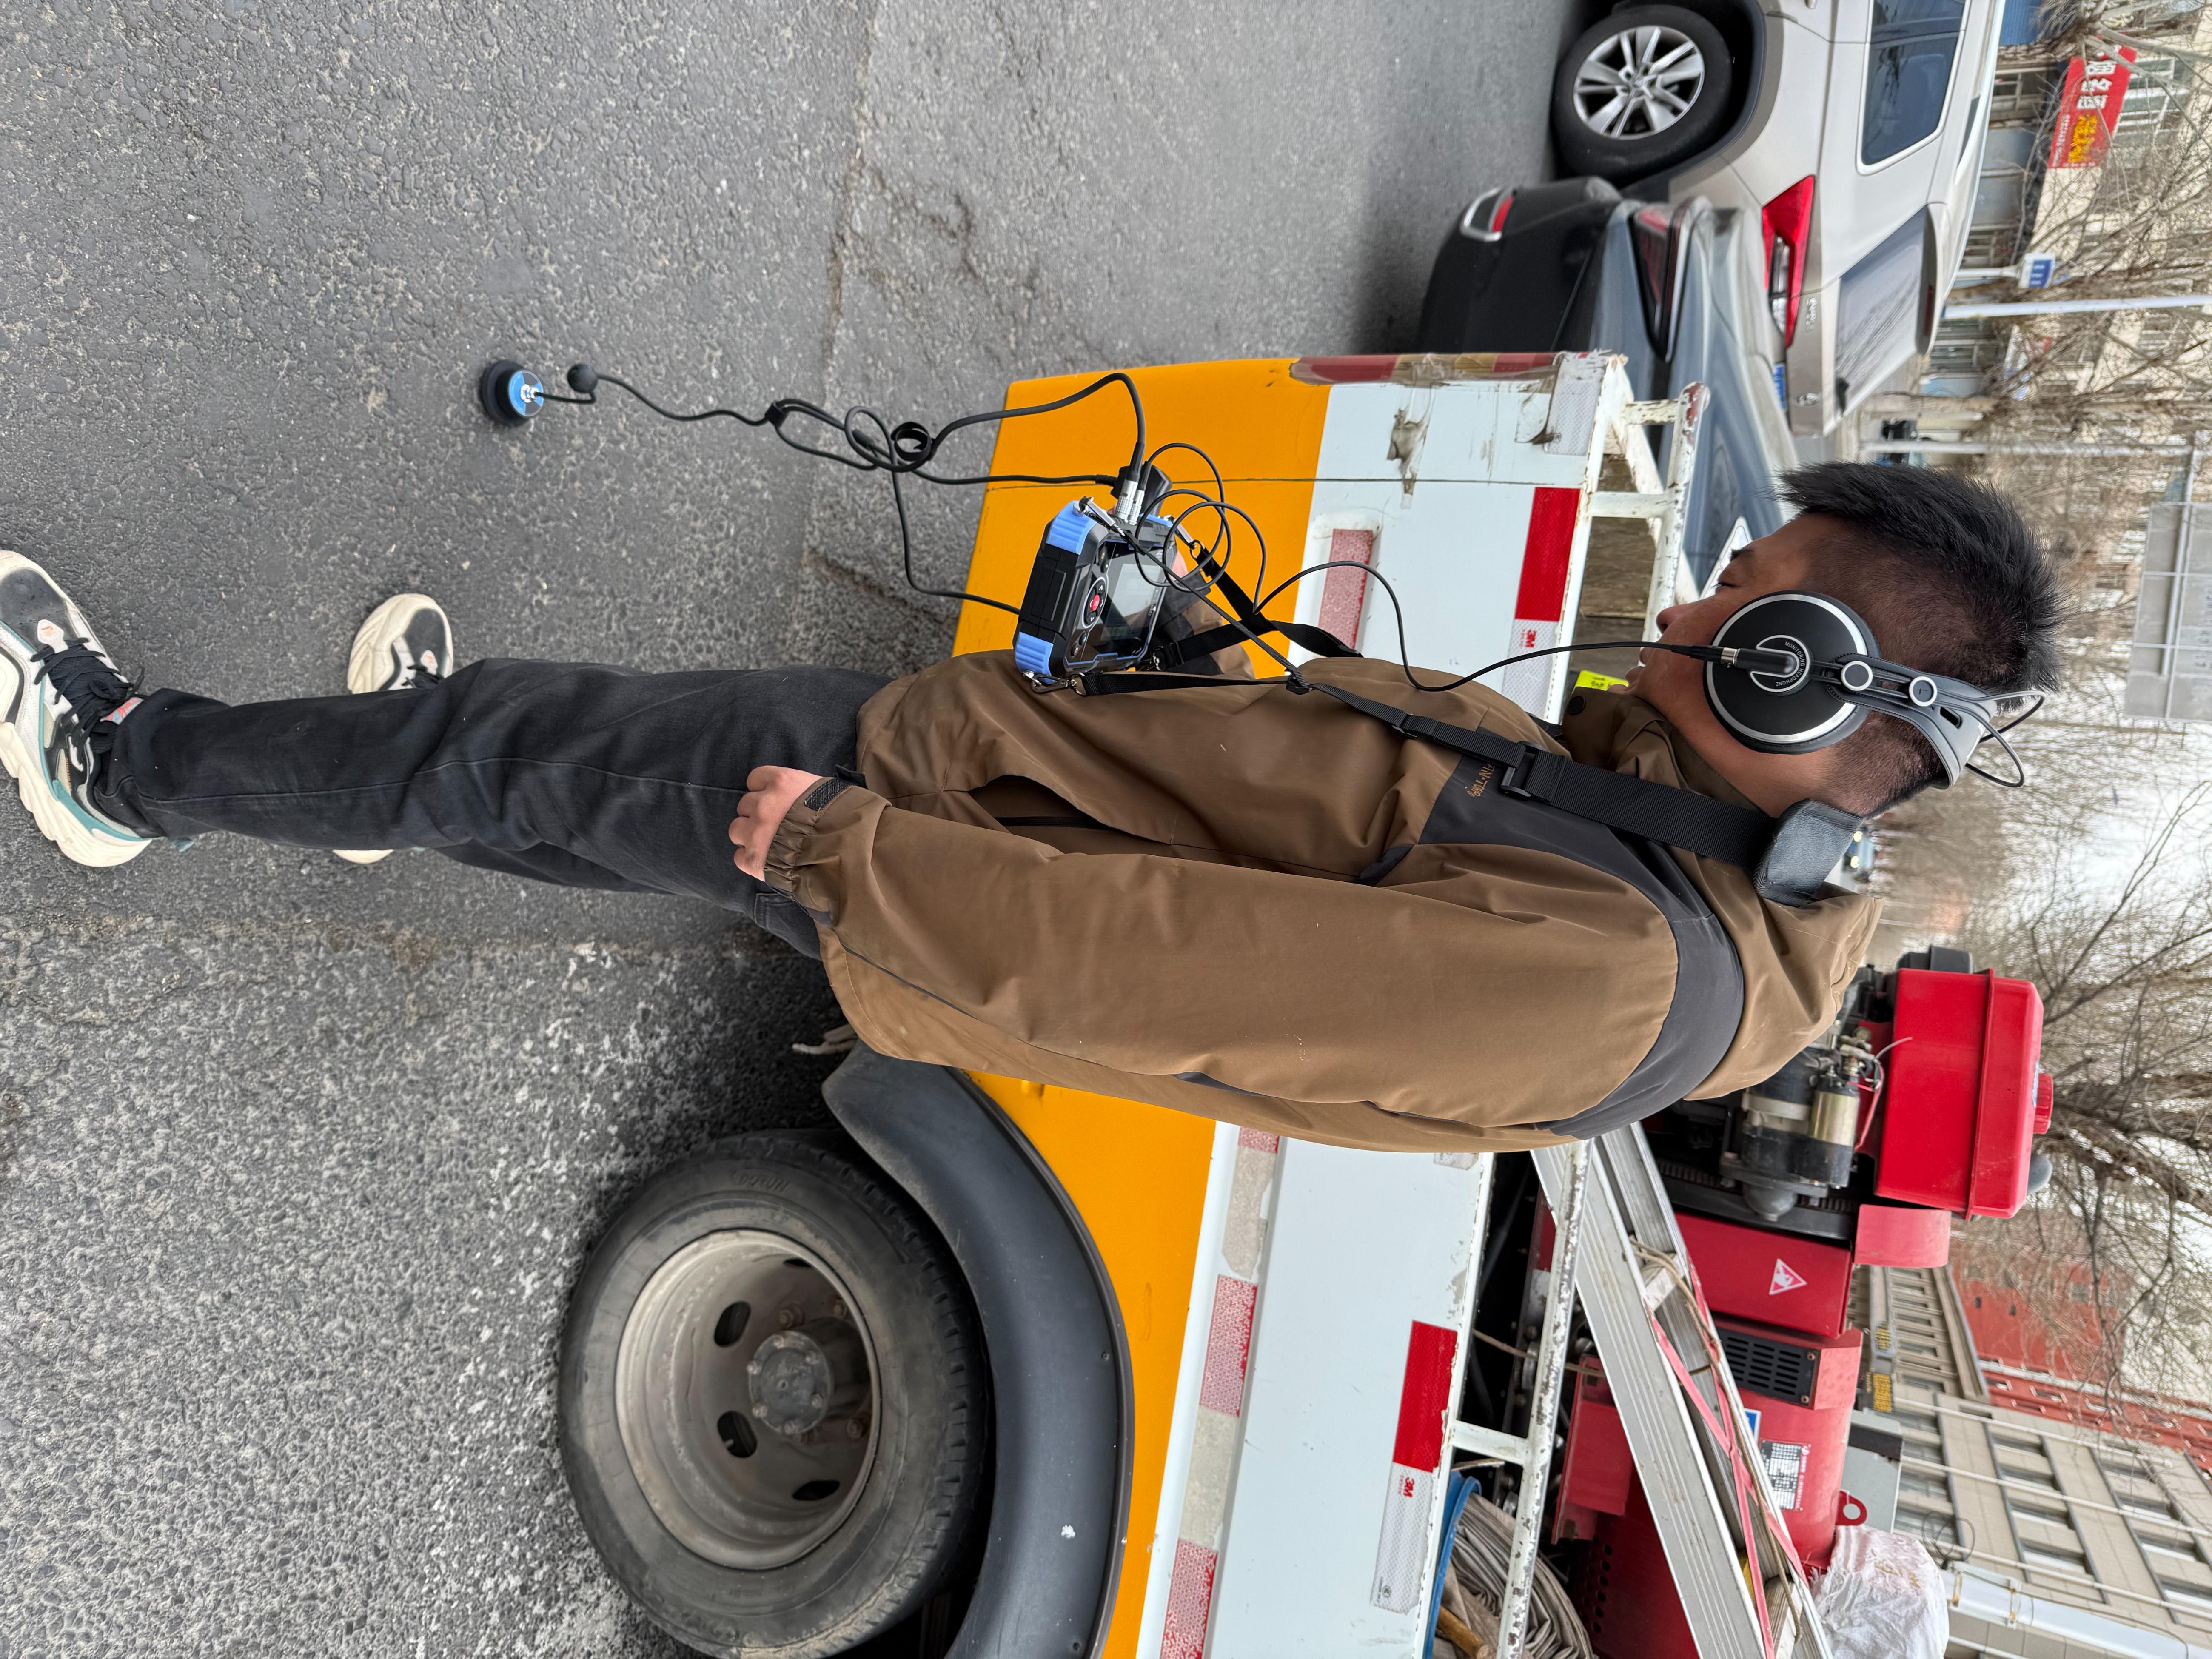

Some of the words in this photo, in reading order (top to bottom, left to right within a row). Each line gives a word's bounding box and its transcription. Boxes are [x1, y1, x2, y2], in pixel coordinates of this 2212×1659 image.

[1525, 630, 1536, 648] 3M
[1784, 641, 1806, 667] MONITORING
[1775, 668, 1804, 687] HEADPHONE
[1403, 1477, 1415, 1497] 3M
